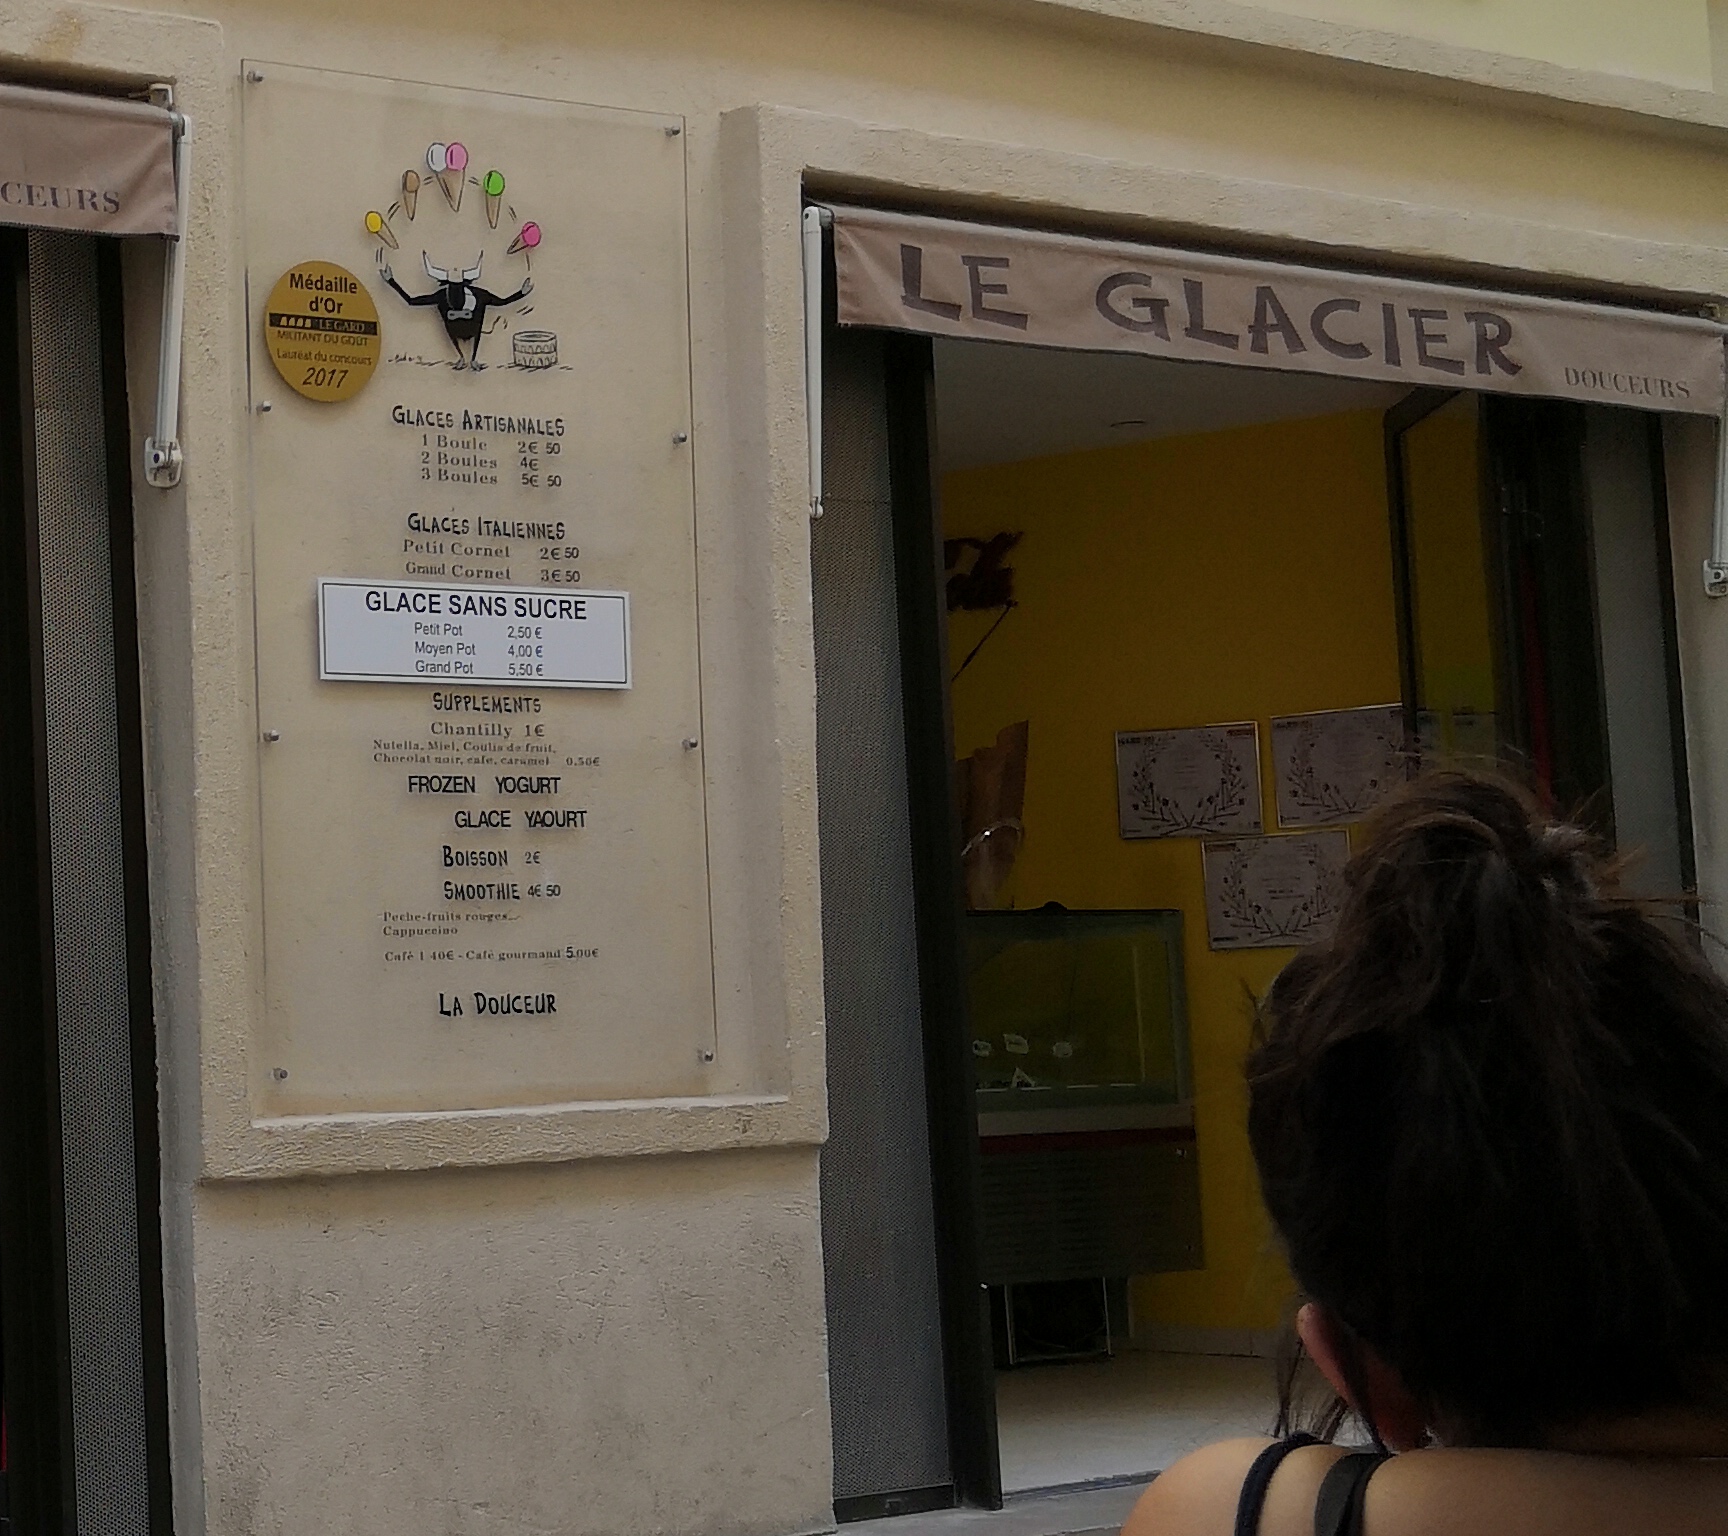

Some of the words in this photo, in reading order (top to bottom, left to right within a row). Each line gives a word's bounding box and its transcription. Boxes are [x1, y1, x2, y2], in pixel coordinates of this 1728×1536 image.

[289, 273, 358, 295] Médaille
[309, 296, 343, 314] d'Or
[319, 320, 333, 331] LE
[334, 321, 365, 333] GARD
[899, 242, 1029, 331] LE
[1095, 271, 1523, 378] GLACIER
[1563, 366, 1692, 402] DOUCEURS
[277, 330, 322, 343] MILITANT
[324, 333, 338, 344] DU
[314, 350, 327, 362] du
[329, 354, 372, 366] concours
[302, 367, 349, 389] 2017
[421, 433, 429, 447] 1
[437, 434, 488, 451] Boule
[517, 441, 539, 455] 2€
[545, 442, 562, 455] 50
[421, 451, 430, 464] 2
[437, 451, 498, 469] Boules
[520, 457, 540, 472] 4€
[421, 467, 431, 481] 3
[437, 467, 498, 485] Boules
[521, 474, 540, 488] 5€
[547, 475, 562, 488] 50
[403, 539, 444, 555] Petit
[451, 542, 511, 558] Cornet
[540, 547, 561, 561] 2€
[564, 546, 580, 559] 50
[405, 561, 445, 576] Grand
[451, 564, 512, 580] Cornet
[540, 569, 561, 583] 3€
[565, 570, 581, 583] 50
[365, 591, 442, 614] GLACE
[448, 594, 508, 618] SANS
[514, 597, 588, 621] SUCRE
[414, 622, 441, 636] Petit
[443, 624, 463, 637] Pot
[507, 626, 533, 640] 2,50
[534, 626, 543, 640] €
[414, 641, 454, 657] Moyen
[456, 643, 476, 656] Pot
[507, 645, 533, 659] 4,00
[534, 645, 544, 658] €
[415, 660, 451, 674] Grand
[454, 661, 474, 675] Pot
[507, 663, 533, 677] 5,50
[534, 663, 544, 677] €
[430, 721, 514, 739] Chantilly
[524, 724, 545, 738] 1€
[506, 742, 522, 753] de
[373, 753, 431, 764] Chocolat
[500, 757, 550, 767] caramel
[408, 775, 476, 794] FROZEN
[495, 775, 561, 794] YOGURT
[454, 810, 512, 828] GLACE
[524, 810, 588, 828] YAOURT
[524, 851, 541, 865] 2€
[527, 884, 542, 898] 4€
[545, 884, 562, 897] 50
[382, 926, 459, 937] Cappuccino
[498, 949, 561, 962] gourmand
